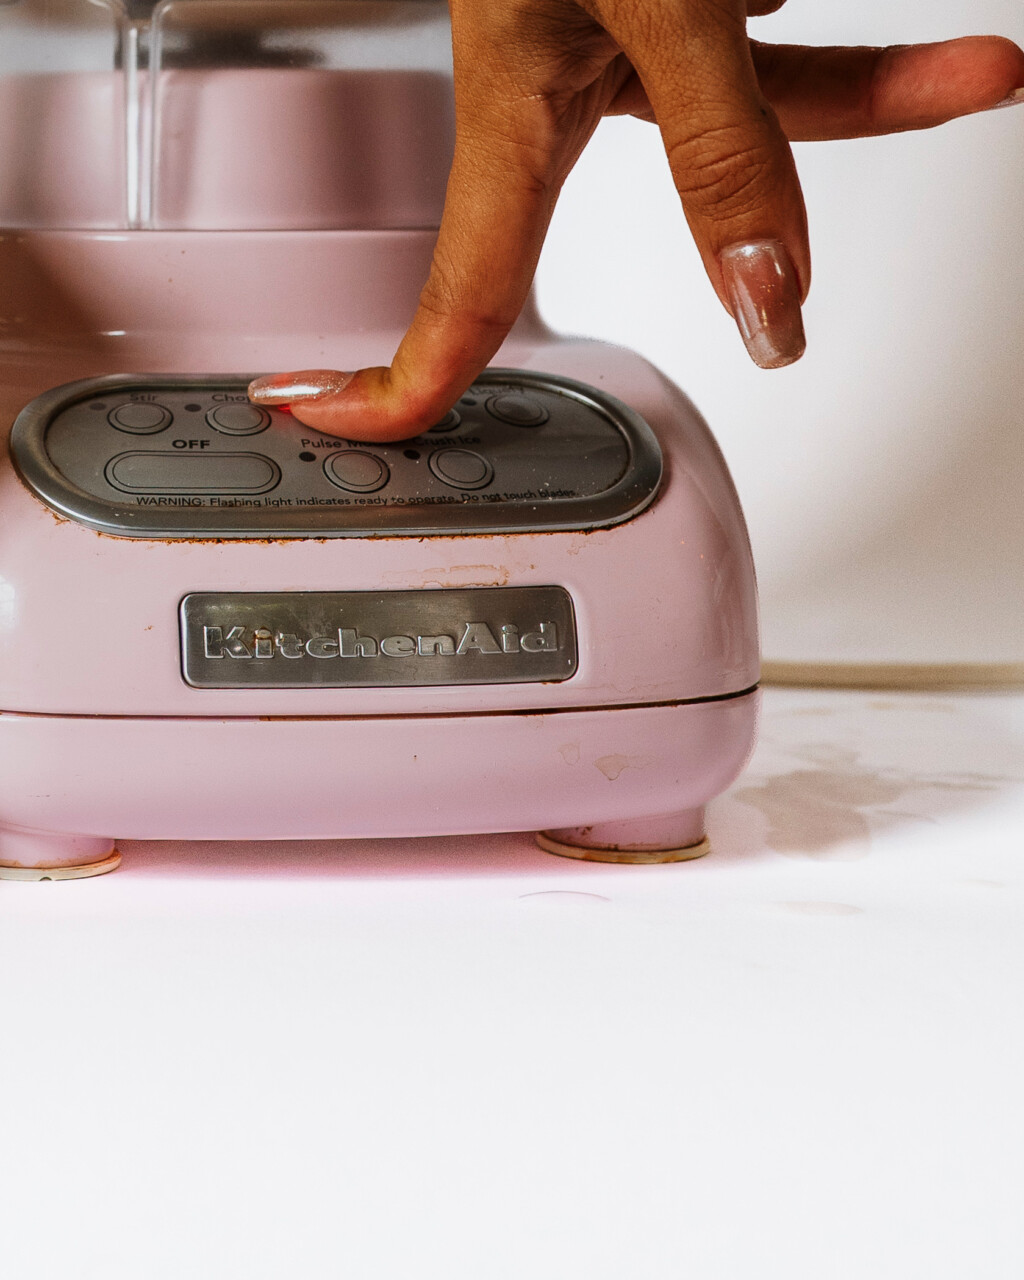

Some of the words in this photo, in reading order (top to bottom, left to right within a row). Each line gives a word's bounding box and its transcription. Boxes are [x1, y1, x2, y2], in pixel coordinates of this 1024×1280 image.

[129, 393, 157, 402] Stir
[172, 439, 210, 449] OFF
[301, 438, 341, 449] Pulse
[412, 435, 456, 447] Crush
[459, 435, 481, 445] Ice
[136, 496, 206, 507] WARNING:
[210, 497, 261, 508] Flashing
[265, 496, 292, 507] light
[296, 495, 350, 506] indicates
[354, 495, 387, 507] ready
[391, 495, 404, 505] to
[462, 493, 478, 503] Do
[483, 492, 502, 503] not
[504, 489, 537, 501] touch
[203, 620, 561, 659] KitchenAid
